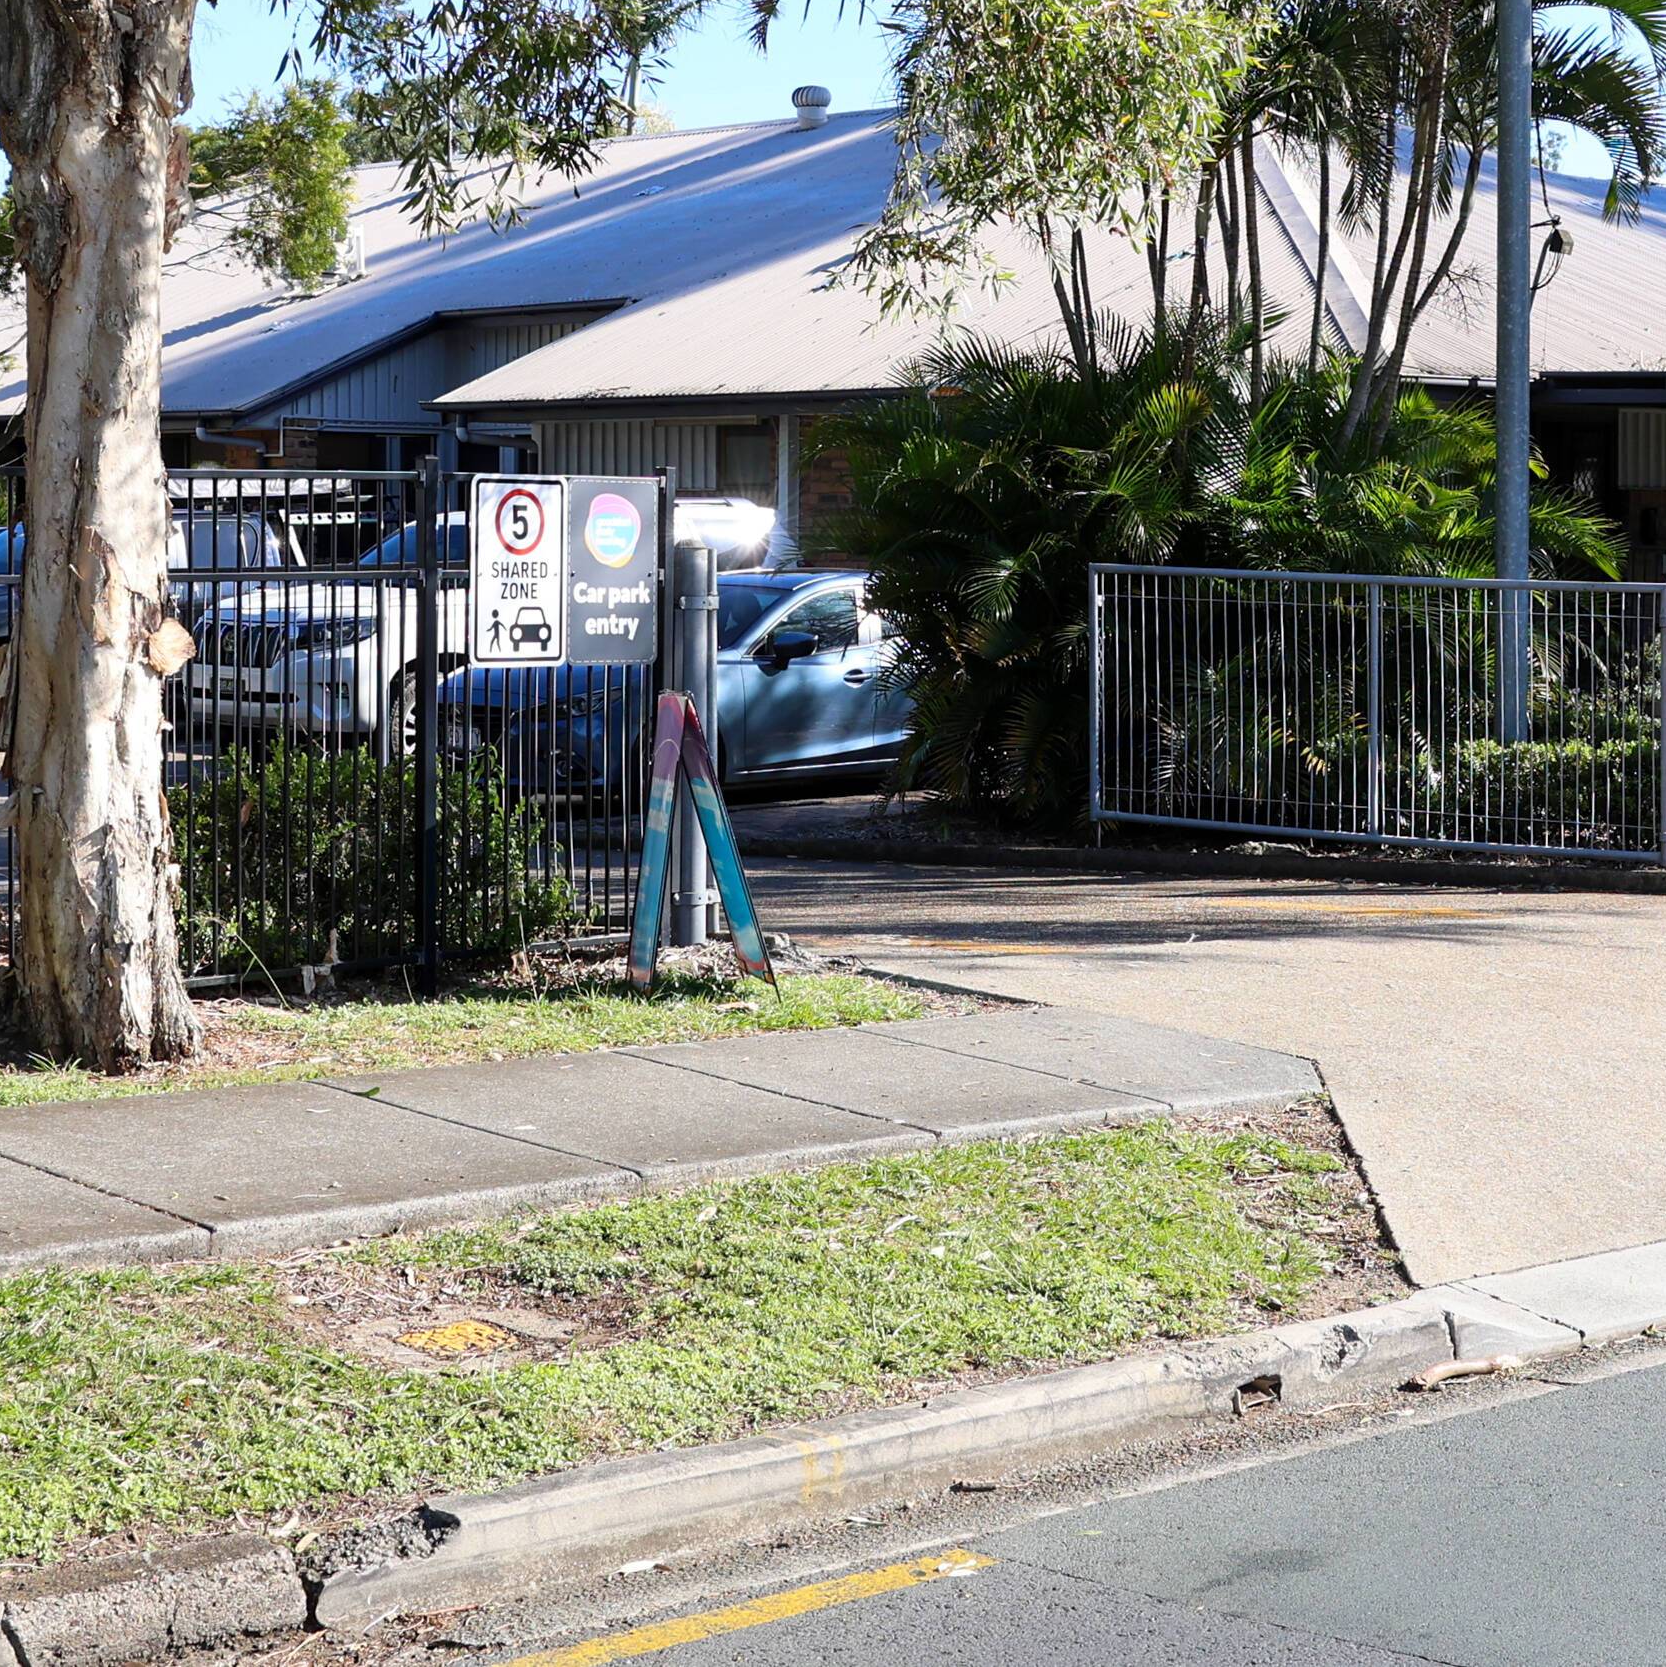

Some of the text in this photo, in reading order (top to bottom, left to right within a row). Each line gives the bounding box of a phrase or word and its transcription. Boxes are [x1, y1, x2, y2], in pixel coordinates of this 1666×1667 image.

[512, 504, 528, 540] 5
[491, 561, 548, 578] SHARED
[500, 583, 538, 599] ZONE
[573, 581, 651, 609] Car park
[585, 614, 639, 640] entry
